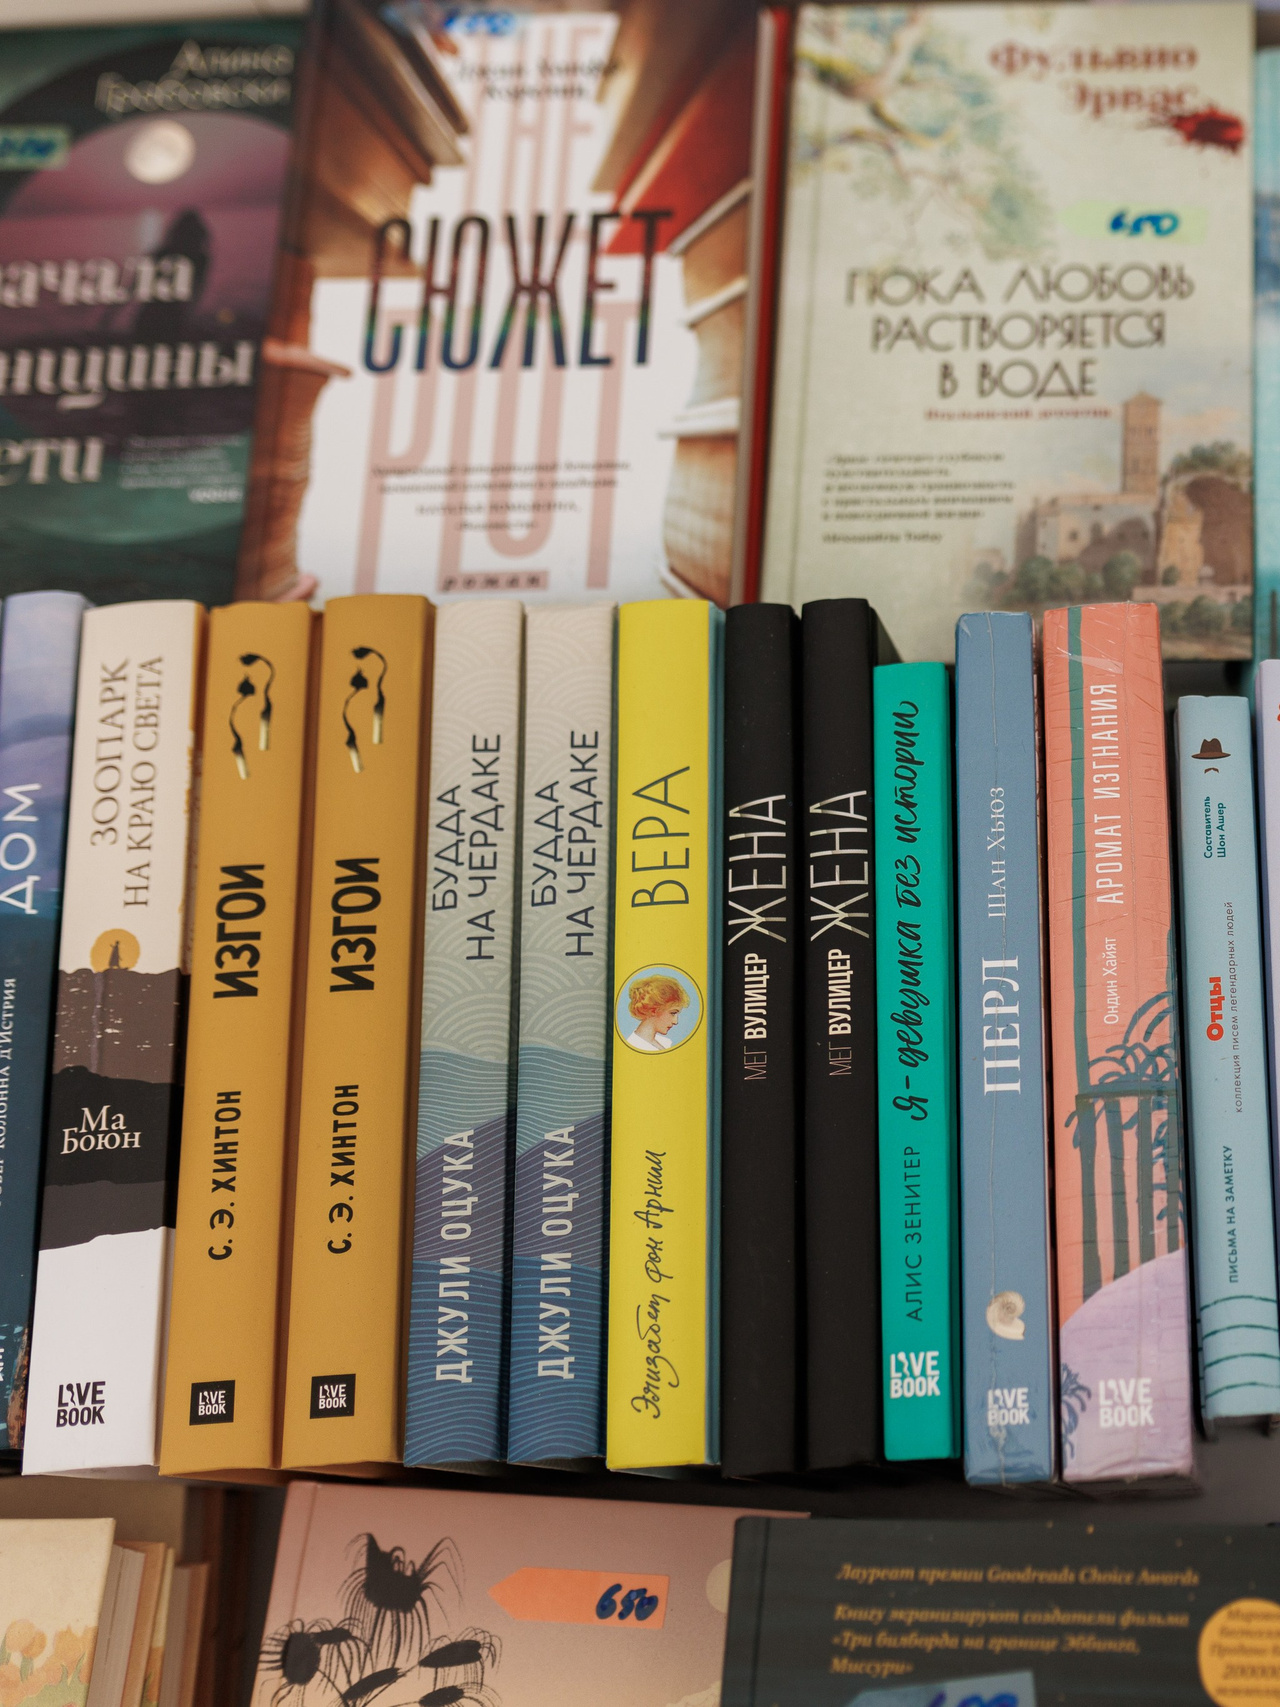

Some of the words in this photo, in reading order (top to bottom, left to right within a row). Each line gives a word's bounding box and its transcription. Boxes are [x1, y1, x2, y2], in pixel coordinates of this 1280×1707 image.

[363, 209, 673, 375] СЮЖЕТ
[846, 267, 985, 306] ПОКА
[1004, 262, 1195, 302] ЛЮБОВЬ
[870, 310, 1166, 353] РАСТВОРЯЕТСЯ
[939, 360, 958, 399] В
[977, 358, 1098, 401] ВОДЕ
[133, 654, 165, 753] СВЕТА
[1090, 682, 1122, 800] ИЗГНАНИЯ
[90, 657, 130, 847] ЗООПАРК
[893, 700, 925, 844] истории
[0, 783, 43, 915] ДОМ
[126, 761, 157, 852] КРАЮ
[432, 784, 465, 912] БУДДА
[468, 733, 504, 899] ЧЕРДАКЕ
[531, 780, 564, 907] БУДДА
[567, 730, 603, 896] ЧЕРДАКЕ
[631, 766, 690, 909] ВЕРА
[986, 786, 1006, 852] ХЬЮЗ
[123, 860, 150, 909] НА
[728, 794, 787, 946] ЖЕНА
[809, 790, 869, 941] ЖЕНА
[896, 853, 922, 908] без
[988, 858, 1006, 919] ШАН
[1094, 812, 1125, 905] АРОМАТ
[212, 864, 267, 999] ИЗГОИ
[329, 857, 382, 993] ИЗГОИ
[466, 909, 496, 960] НА
[565, 906, 595, 957] НА
[1102, 937, 1117, 976] Хайят
[743, 952, 770, 1040] ВУЛИЦЕР
[827, 948, 853, 1035] ВУЛИЦЕР
[981, 954, 1021, 1097] ПЕРЛ
[1103, 980, 1120, 1025] Ондин
[1206, 976, 1225, 1041] Отцы
[743, 1046, 767, 1081] МЕГ
[828, 1042, 853, 1076] МЕГ
[60, 1126, 141, 1156] Боюн
[79, 1104, 127, 1132] Ма
[211, 1090, 242, 1193] ХИНТОН
[330, 1084, 360, 1187] ХИНТОН
[209, 1201, 235, 1230] Э.
[328, 1195, 354, 1224] Э.
[440, 1128, 479, 1241] ОЦУКА
[540, 1124, 580, 1237] ОЦУКА
[903, 1145, 923, 1245] ЗЕНИТЕР
[207, 1237, 234, 1261] С.
[327, 1232, 353, 1255] С.
[435, 1256, 473, 1384] ДЖУЛИ
[537, 1252, 575, 1380] ДЖУЛИ
[905, 1253, 923, 1322] АЛИС
[55, 1405, 106, 1428] BOOK
[198, 1403, 227, 1416] BOOK
[889, 1376, 940, 1399] BOOK
[987, 1405, 1030, 1426] BOOK
[1099, 1403, 1155, 1430] BOOK
